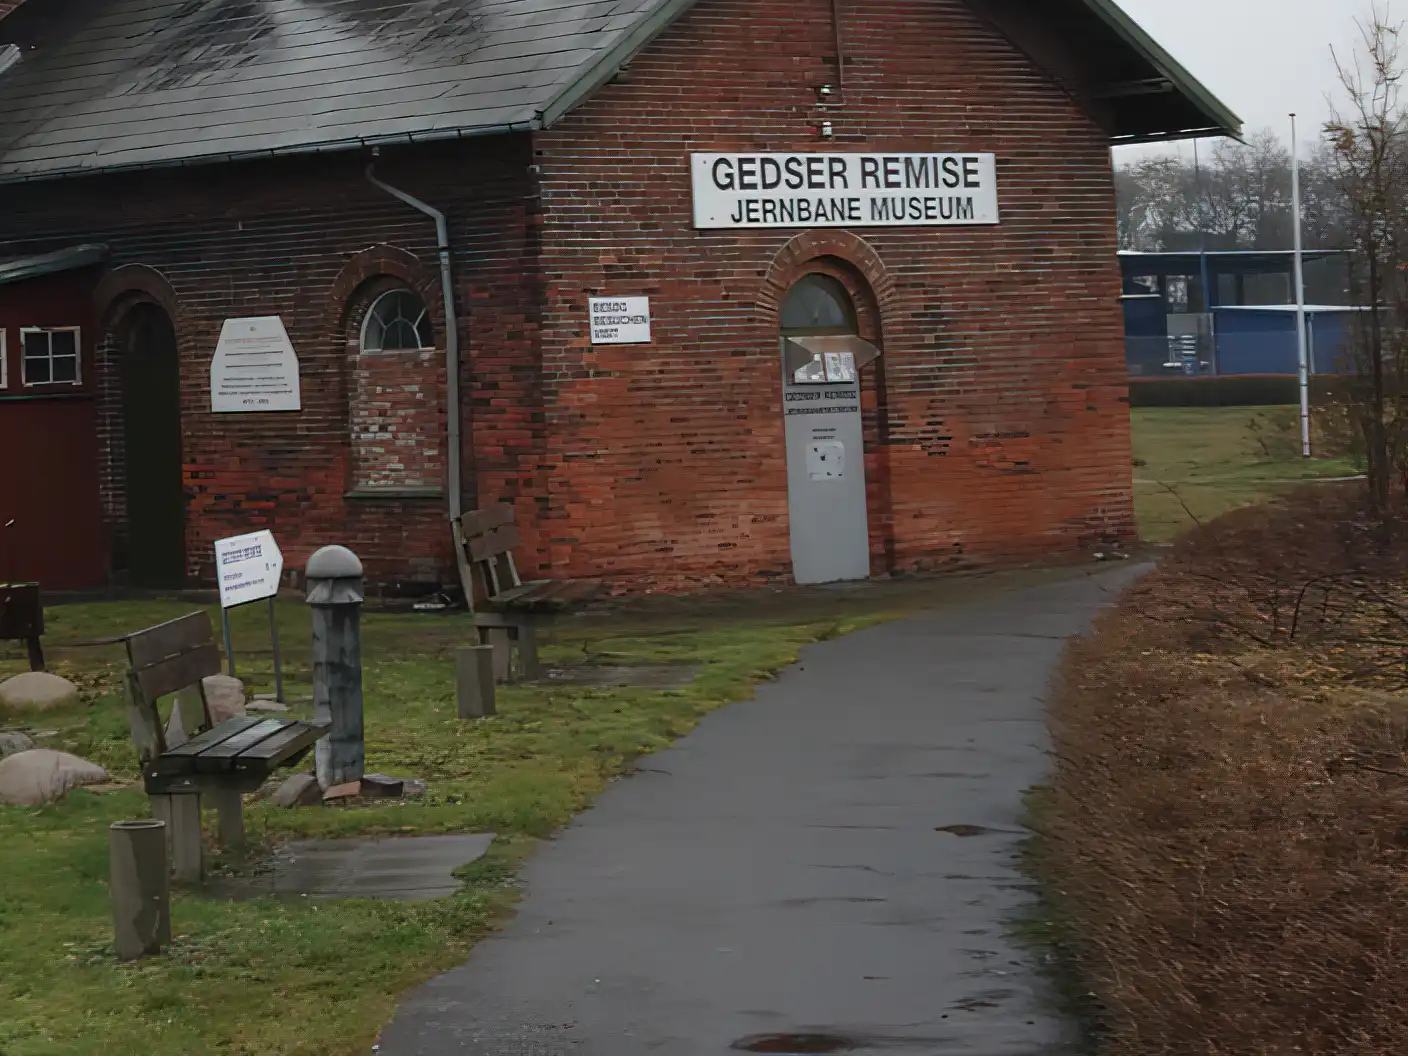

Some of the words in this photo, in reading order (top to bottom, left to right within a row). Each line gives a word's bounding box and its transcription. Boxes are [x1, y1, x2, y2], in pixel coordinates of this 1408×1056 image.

[711, 157, 848, 190] GEDSER
[860, 156, 981, 189] REMISE
[730, 197, 862, 223] JERNBANE
[870, 196, 975, 221] MUSEUM
